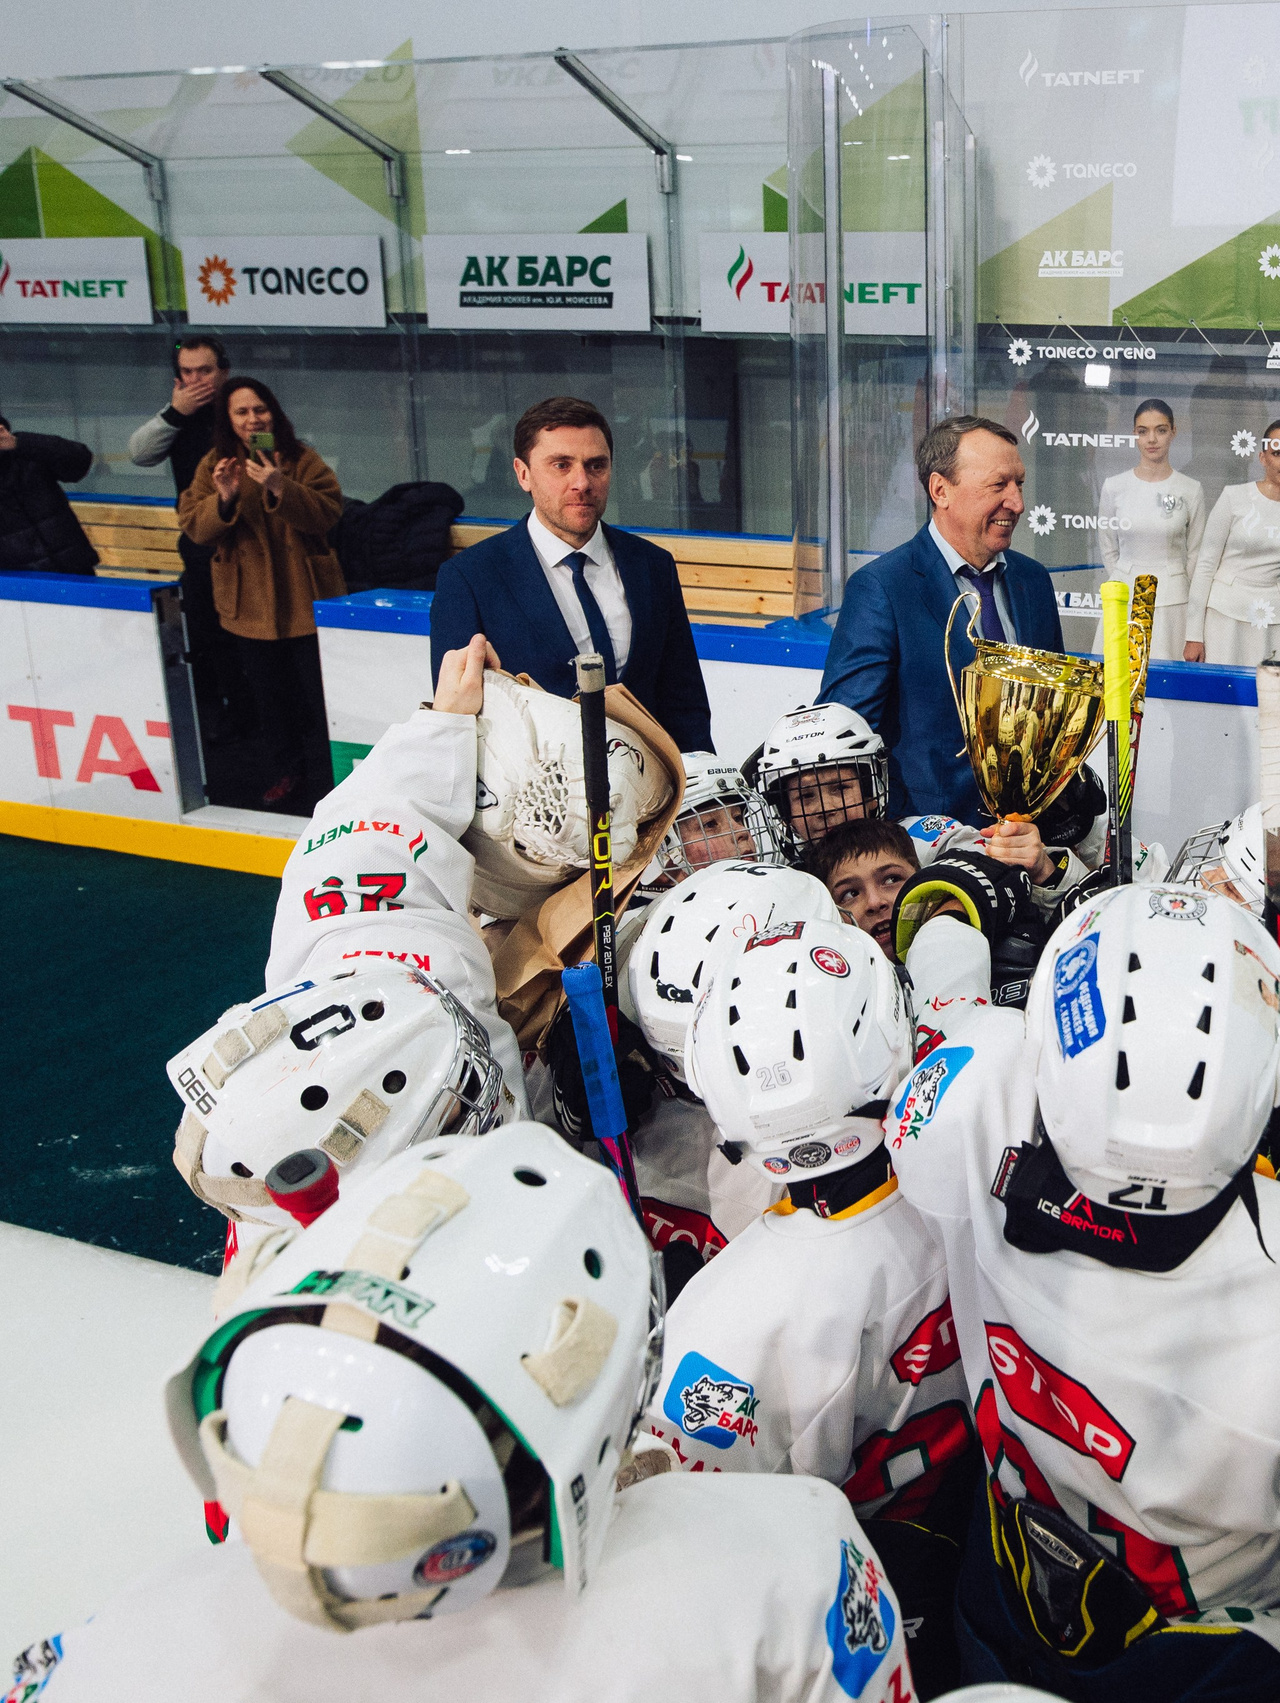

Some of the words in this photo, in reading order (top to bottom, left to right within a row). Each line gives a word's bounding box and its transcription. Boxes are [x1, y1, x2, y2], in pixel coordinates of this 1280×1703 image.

[1041, 69, 1144, 87] TATNEFT
[1062, 162, 1137, 179] TANECO
[1038, 250, 1069, 267] АК
[1071, 250, 1124, 267] БАРС
[241, 266, 369, 296] TANECO
[459, 255, 510, 287] АК
[516, 255, 612, 288] БАРС
[16, 280, 128, 298] TATNEFT
[1037, 346, 1096, 359] TANECO
[1042, 432, 1140, 449] TATNEFT
[1061, 514, 1132, 531] TANECO
[303, 820, 405, 856] TATNEFT
[604, 951, 612, 964] 20
[605, 964, 613, 989] FLEX
[756, 1061, 792, 1092] 26
[892, 1097, 916, 1149] БАРС
[906, 1110, 924, 1140] АК
[1037, 1198, 1126, 1243] ICEARMOR
[735, 1397, 760, 1420] АК
[717, 1411, 758, 1447] БАРС
[1030, 1528, 1078, 1565] BAUER
